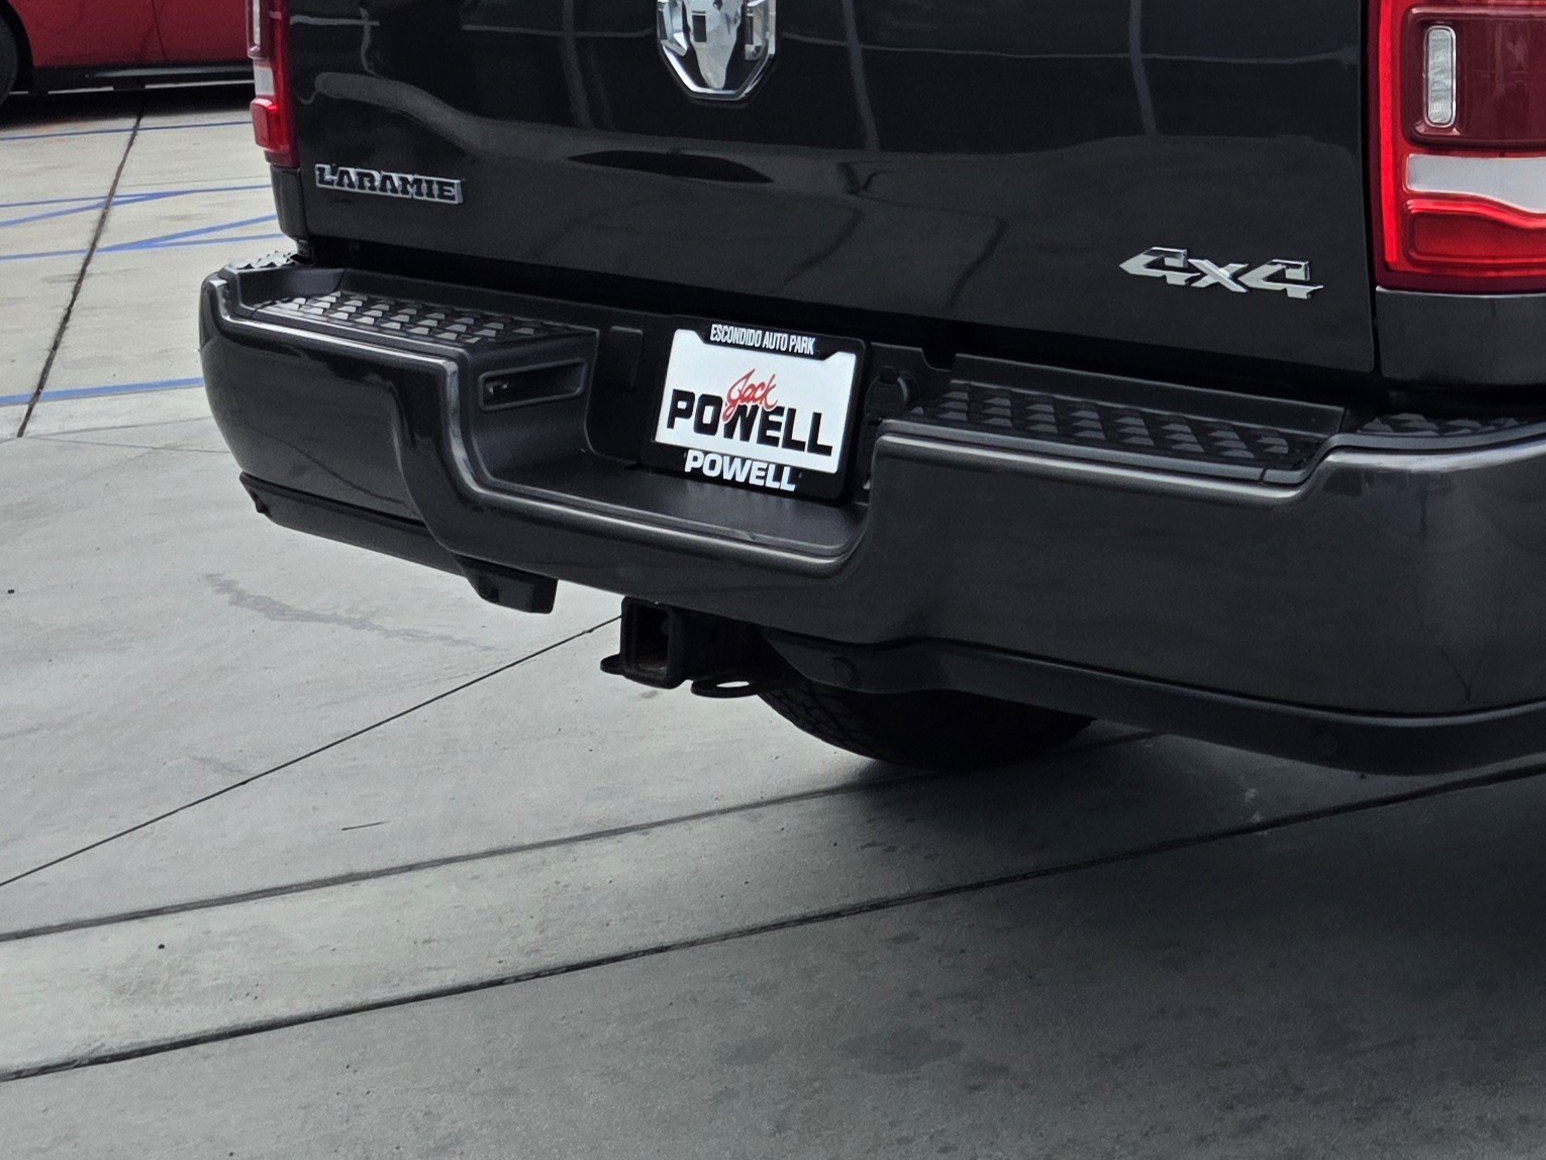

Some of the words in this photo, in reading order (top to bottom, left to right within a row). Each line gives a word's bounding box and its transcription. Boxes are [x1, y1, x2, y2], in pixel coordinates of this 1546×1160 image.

[315, 163, 464, 205] LARAMIE
[709, 323, 761, 348] ESCONDIDO
[763, 332, 789, 352] AUTO
[788, 335, 816, 356] PARK
[722, 368, 778, 422] Jack
[666, 388, 833, 457] POWELL
[684, 449, 796, 492] POWELL
